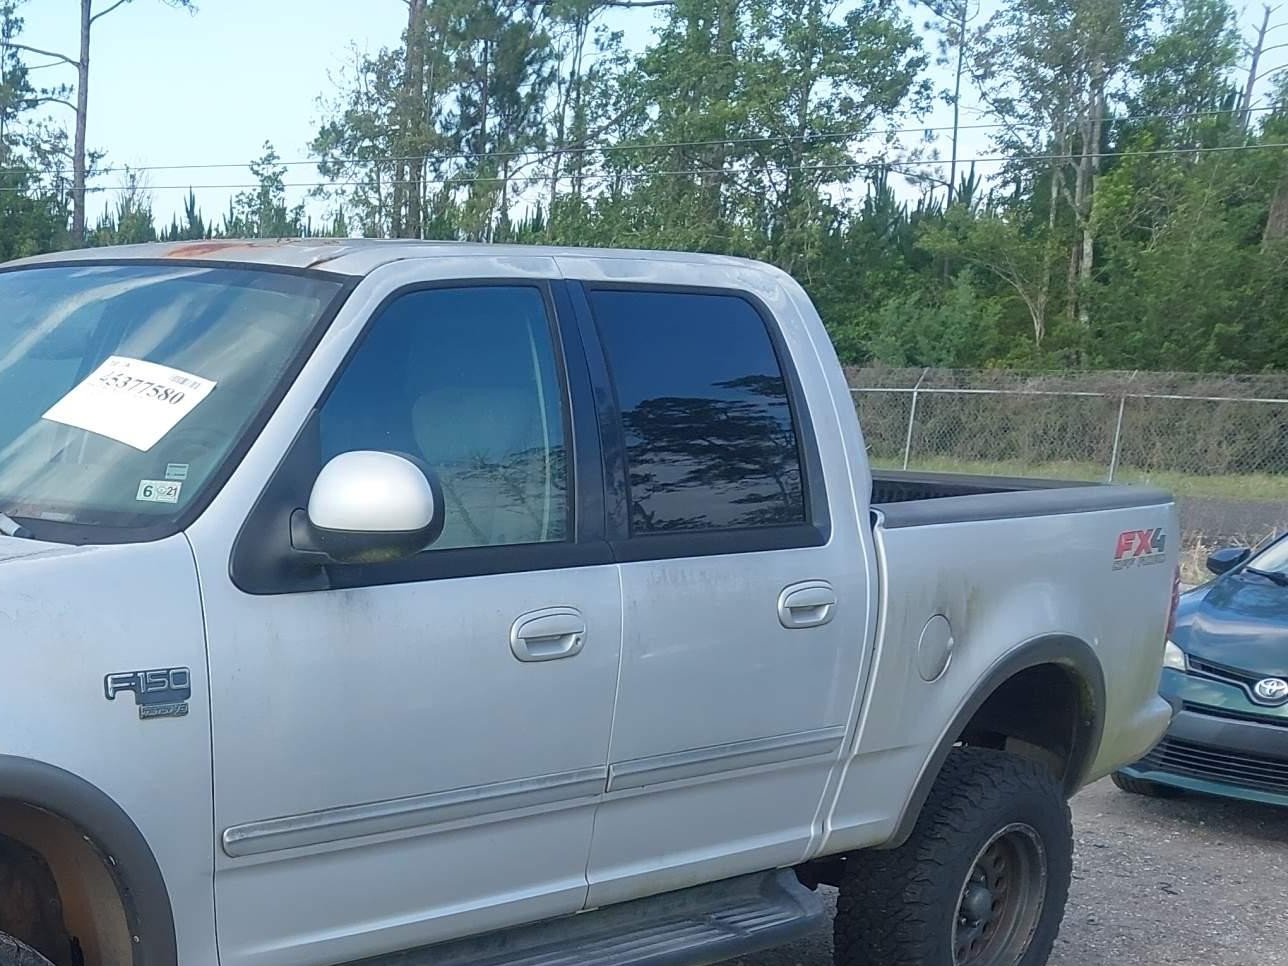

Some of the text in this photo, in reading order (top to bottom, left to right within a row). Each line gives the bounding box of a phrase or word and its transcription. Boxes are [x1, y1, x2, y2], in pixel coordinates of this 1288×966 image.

[143, 485, 178, 497] 6 21
[1114, 527, 1167, 559] FX4
